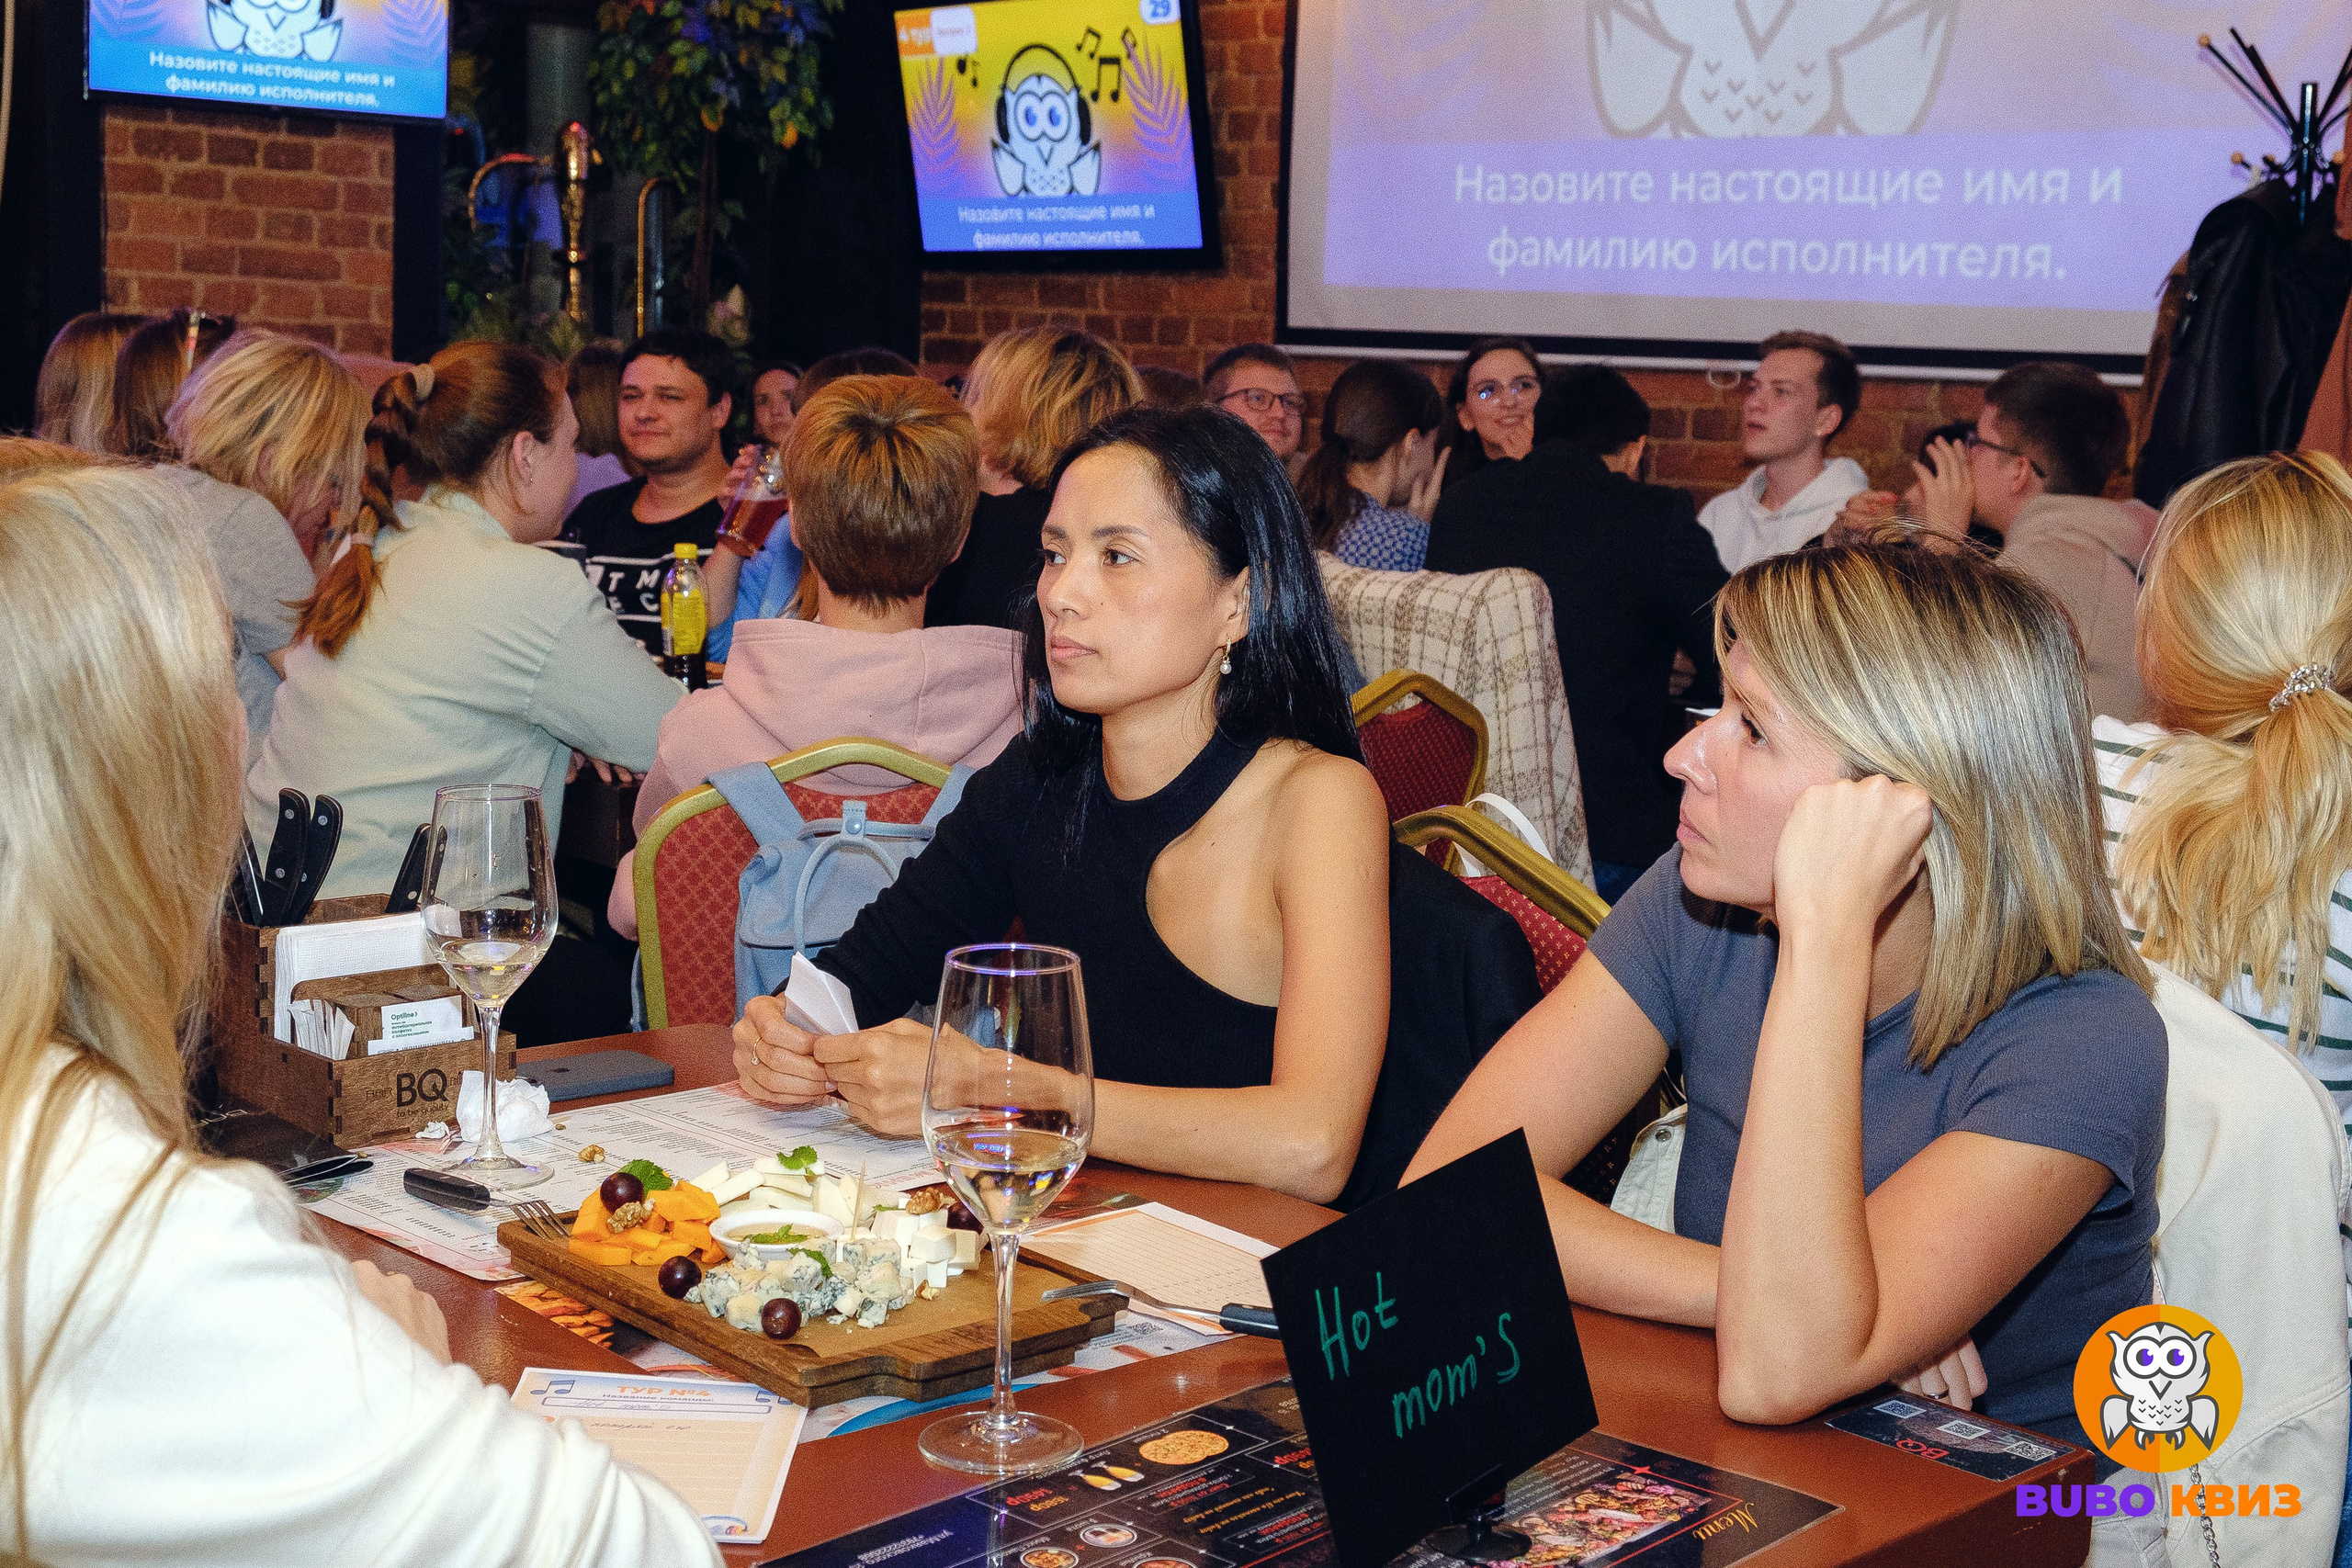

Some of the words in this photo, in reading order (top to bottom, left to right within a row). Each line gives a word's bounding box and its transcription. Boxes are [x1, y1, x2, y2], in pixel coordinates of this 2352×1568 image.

[150, 51, 238, 73] Назовите
[242, 62, 341, 84] настоящие
[345, 73, 379, 86] имя
[383, 74, 395, 87] и
[165, 74, 256, 96] фамилию
[259, 85, 380, 107] исполнителя.
[1454, 164, 1655, 205] Назовите
[1668, 169, 1943, 210] настоящие
[1963, 168, 2068, 205] имя
[2089, 167, 2122, 205] и
[957, 206, 1024, 223] Назовите
[1026, 206, 1108, 222] настоящие
[1110, 205, 1141, 220] имя
[1144, 204, 1156, 218] и
[973, 230, 1042, 250] фамилию
[1487, 226, 1698, 276] фамилию
[1712, 238, 2067, 279] исполнителя.
[390, 1012, 414, 1021] Optiline
[396, 1068, 449, 1108] BQ
[1315, 1271, 1398, 1380] Hot
[616, 1385, 662, 1394] ТУР
[1894, 1438, 1951, 1461] BQ
[1691, 1502, 1759, 1541] Menu
